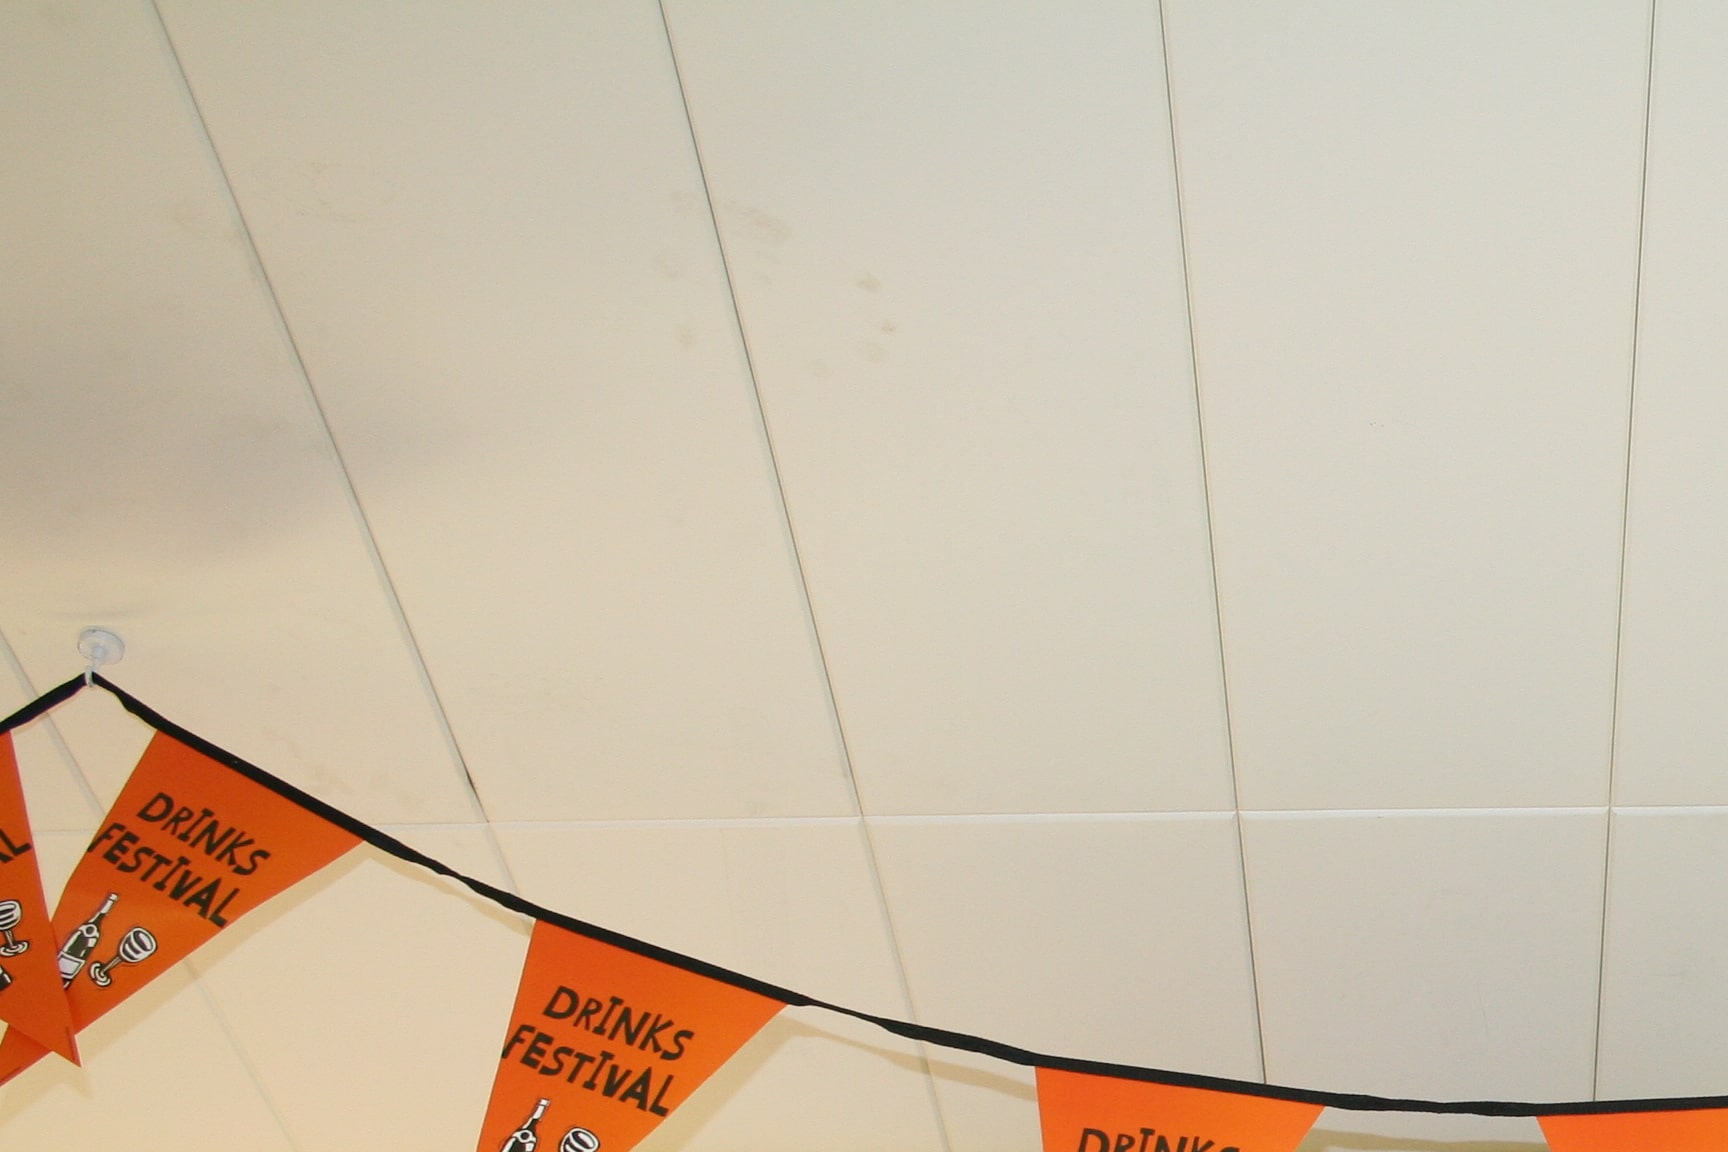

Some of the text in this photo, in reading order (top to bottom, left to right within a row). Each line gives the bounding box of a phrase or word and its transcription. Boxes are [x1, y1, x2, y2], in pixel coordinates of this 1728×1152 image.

[87, 822, 241, 929] FESTIVAL
[136, 791, 271, 877] DRINKS
[542, 985, 696, 1062] DRINKS
[500, 1024, 674, 1117] FESTIVAL
